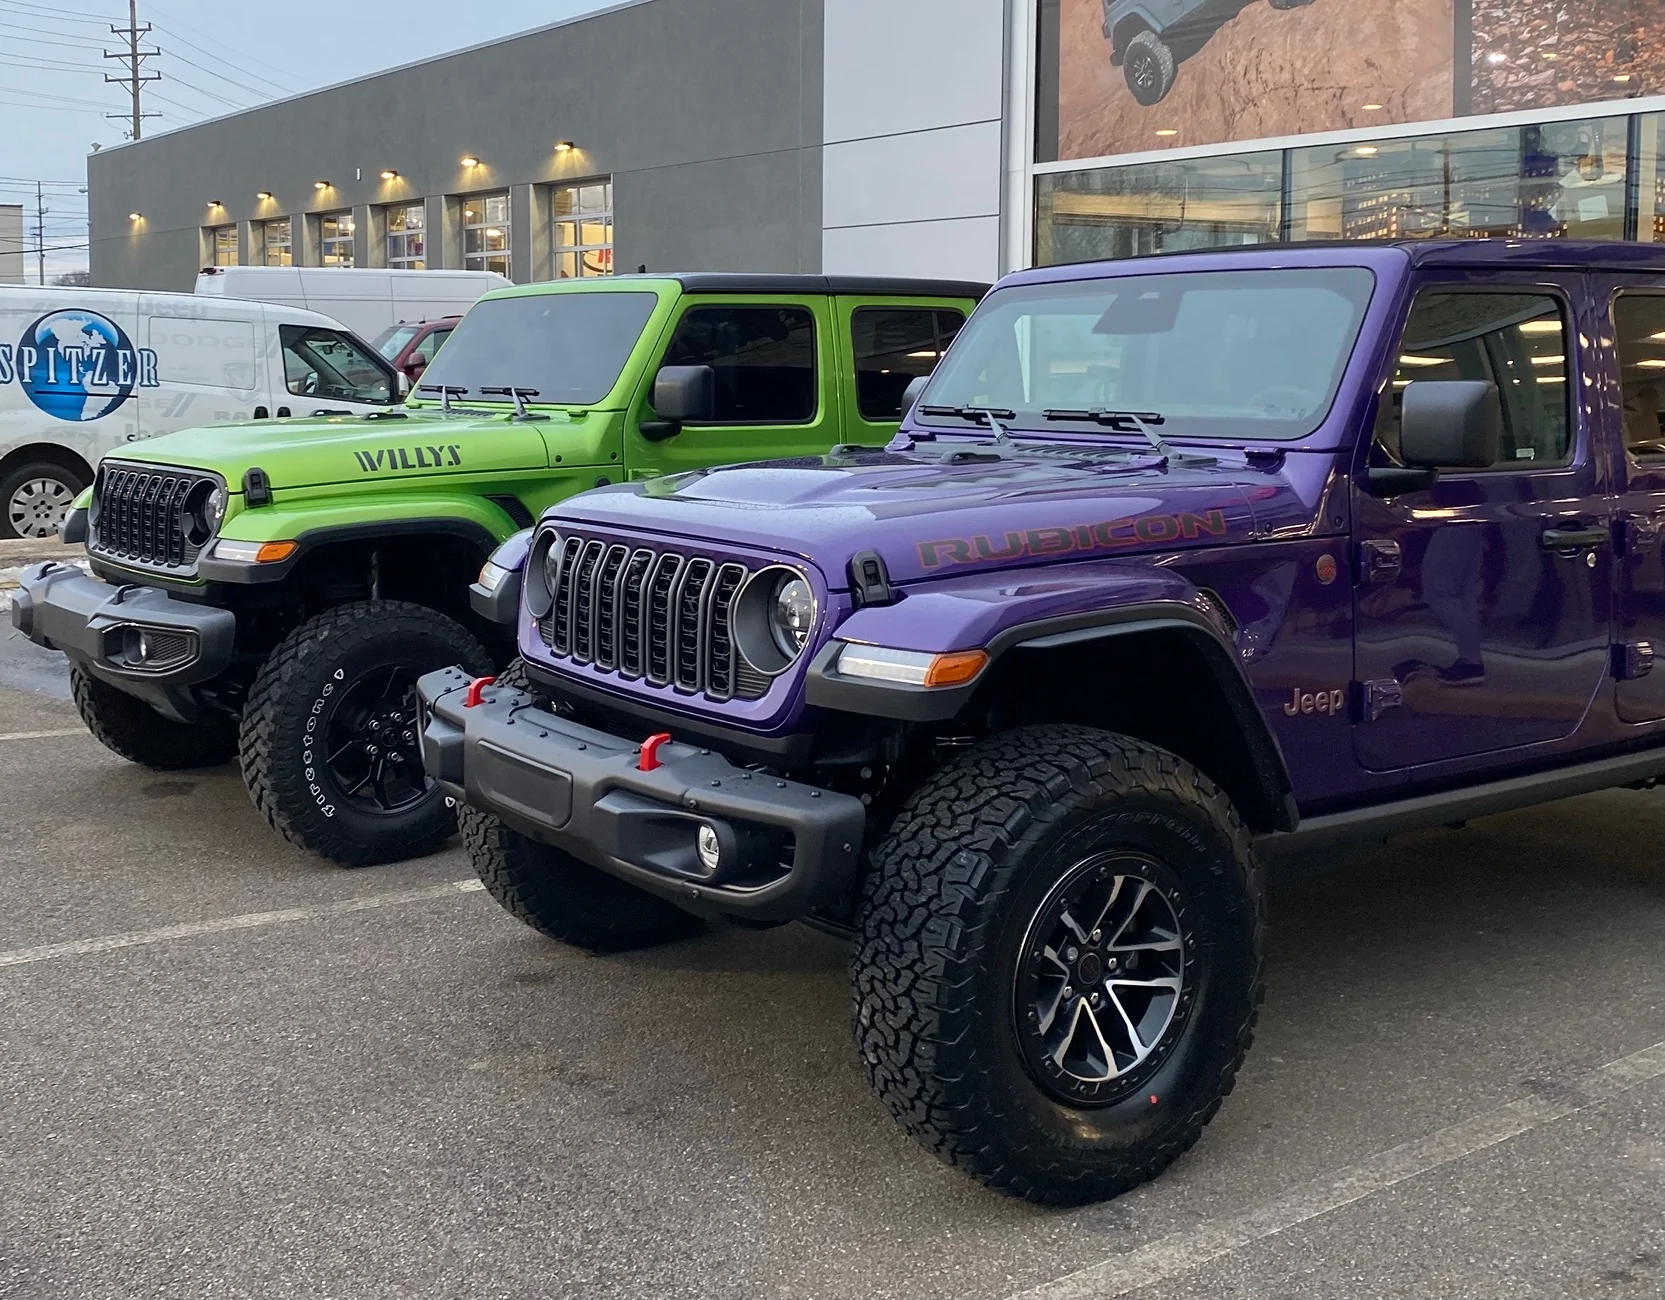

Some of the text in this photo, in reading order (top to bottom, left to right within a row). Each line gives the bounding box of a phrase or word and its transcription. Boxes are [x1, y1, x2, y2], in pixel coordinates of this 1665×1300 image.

[149, 333, 263, 348] DODGE
[0, 344, 160, 387] SPITZER
[213, 410, 251, 420] RA
[353, 444, 461, 472] WILLYS
[916, 509, 1227, 568] RUBICON
[1284, 688, 1344, 716] Jeep
[303, 683, 335, 817] Firestone
